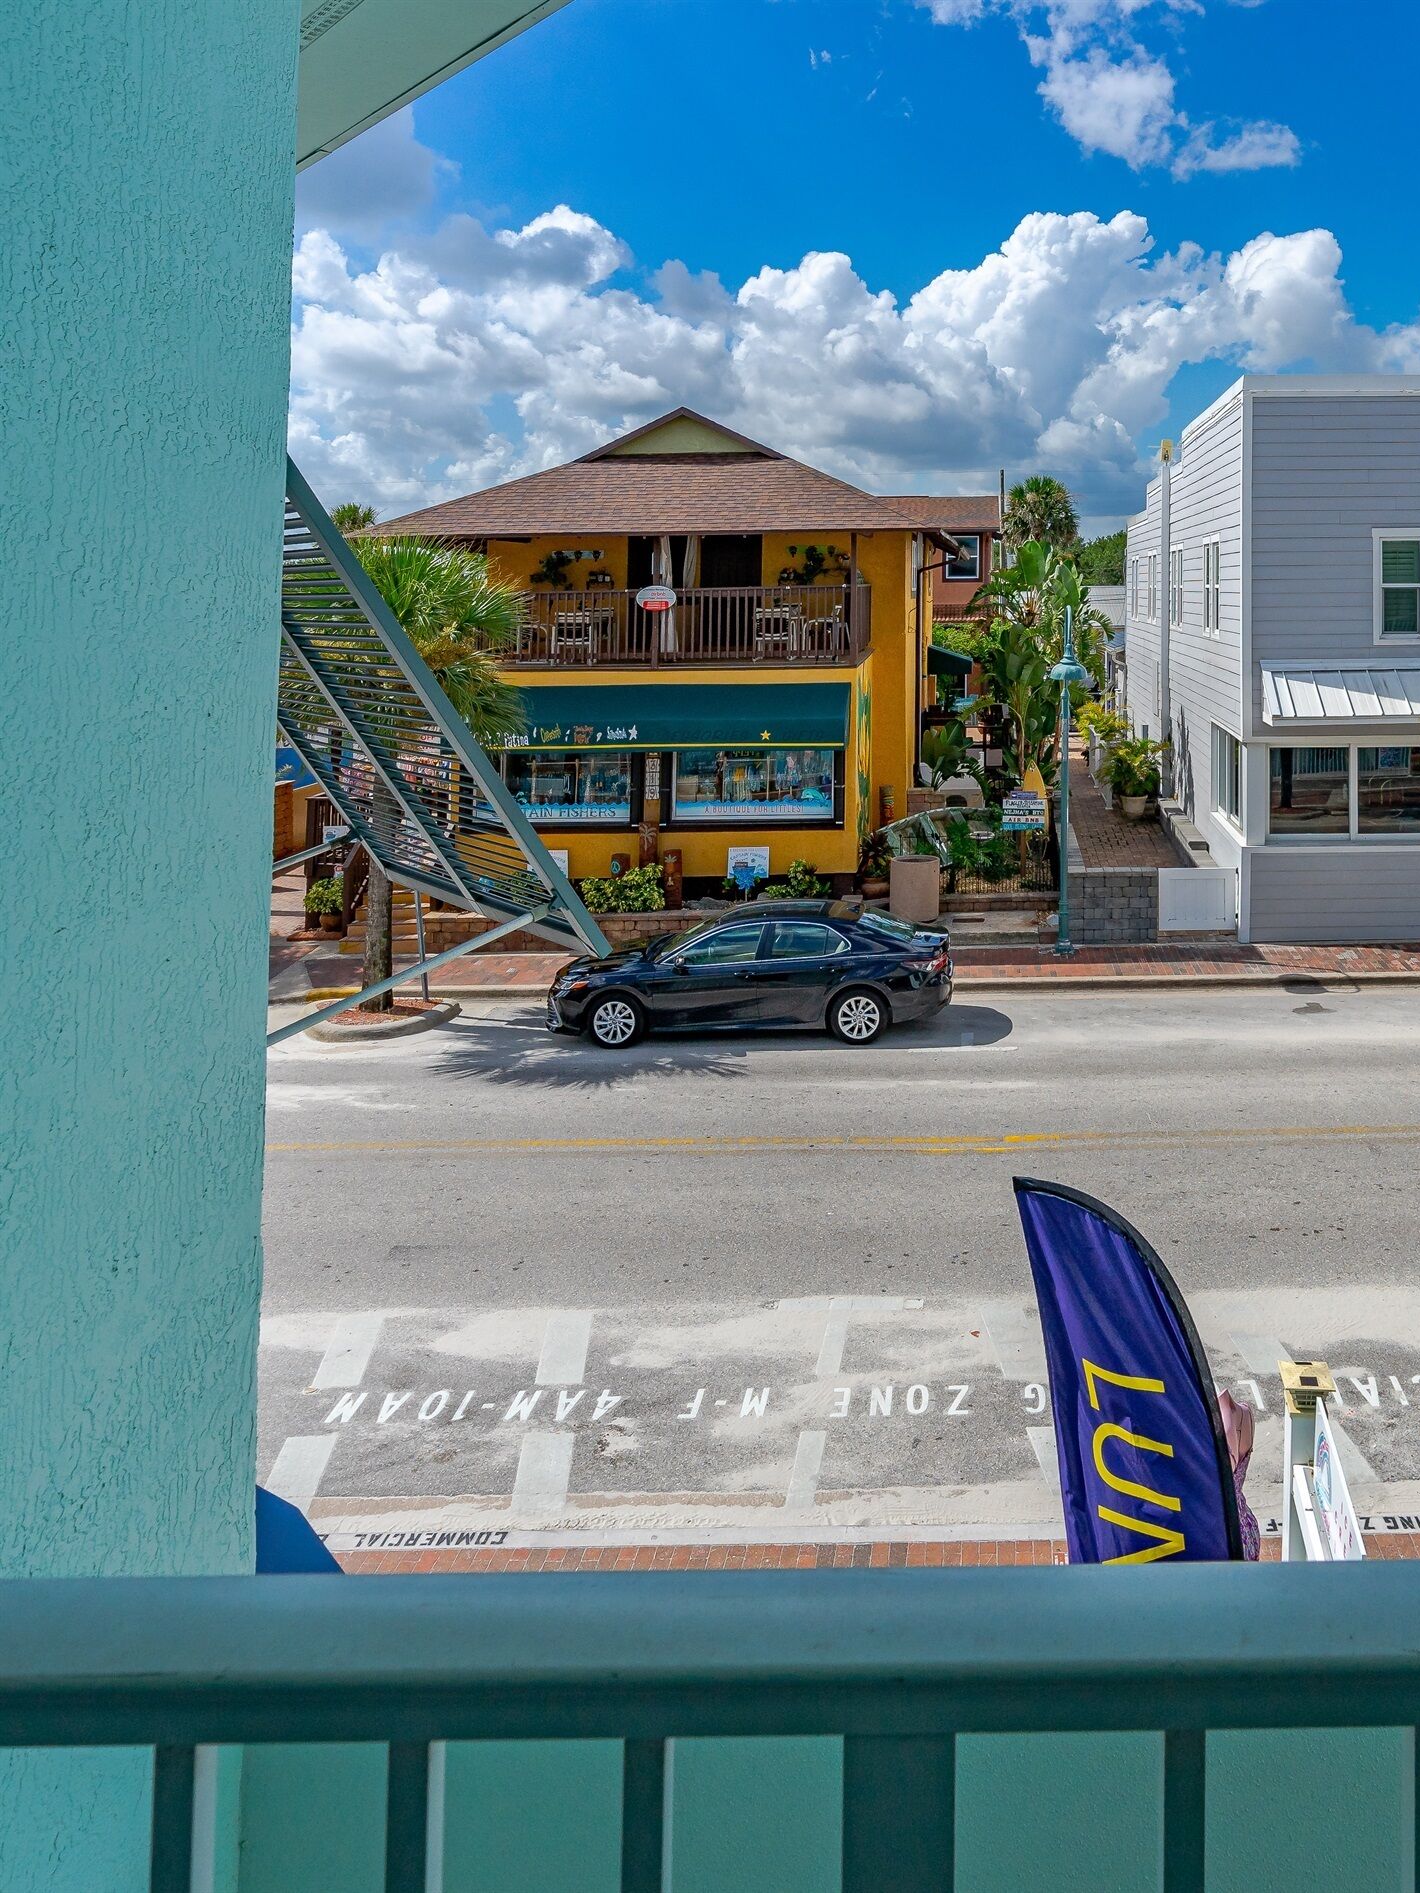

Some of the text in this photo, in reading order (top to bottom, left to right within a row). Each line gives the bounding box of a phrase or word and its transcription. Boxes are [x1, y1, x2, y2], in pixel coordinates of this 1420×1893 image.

[559, 805, 617, 817] FISHERS
[323, 1384, 970, 1424] ZONE M-F 4AM-10AM
[353, 1531, 509, 1548] COMMERCIAL
